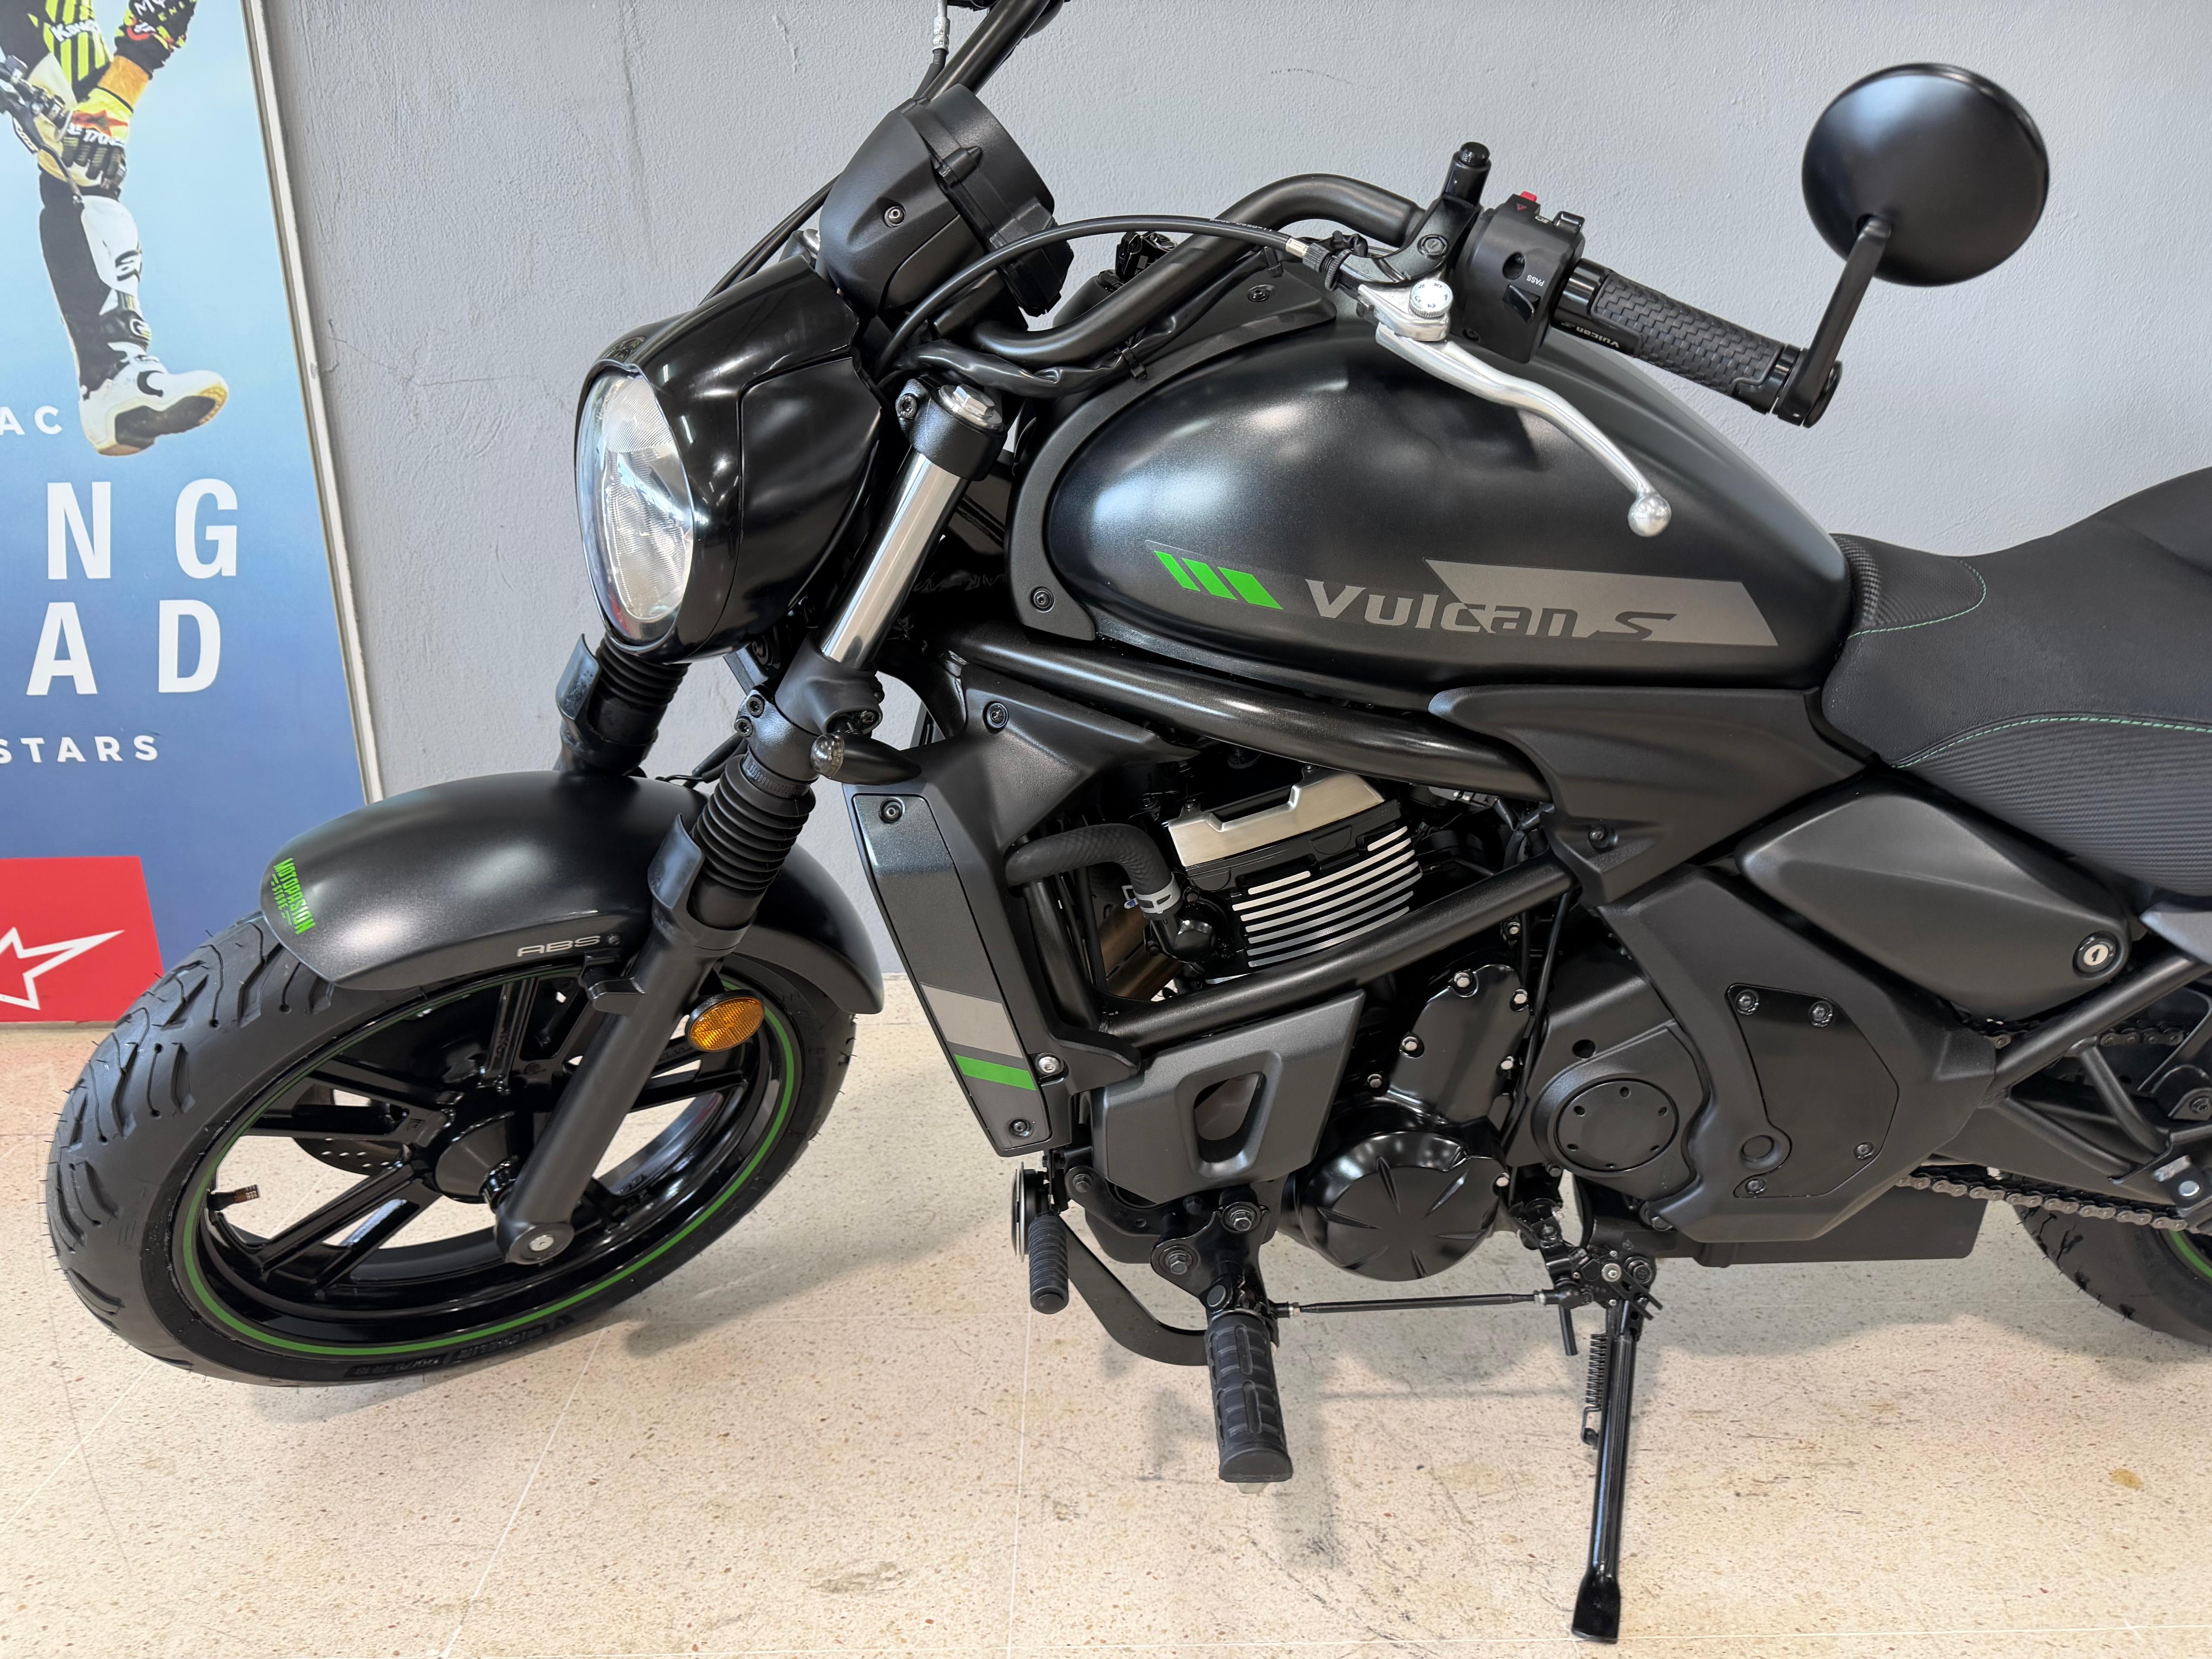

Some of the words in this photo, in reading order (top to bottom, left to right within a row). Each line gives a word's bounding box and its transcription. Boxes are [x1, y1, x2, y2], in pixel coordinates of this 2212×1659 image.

[1526, 274, 1545, 287] PASS
[1576, 326, 1620, 349] Vulcan
[1304, 578, 1577, 639] Vulcan
[1586, 613, 1677, 641] S
[271, 885, 289, 911] STORE
[273, 858, 316, 935] MOTOPASION
[517, 935, 601, 957] ABS
